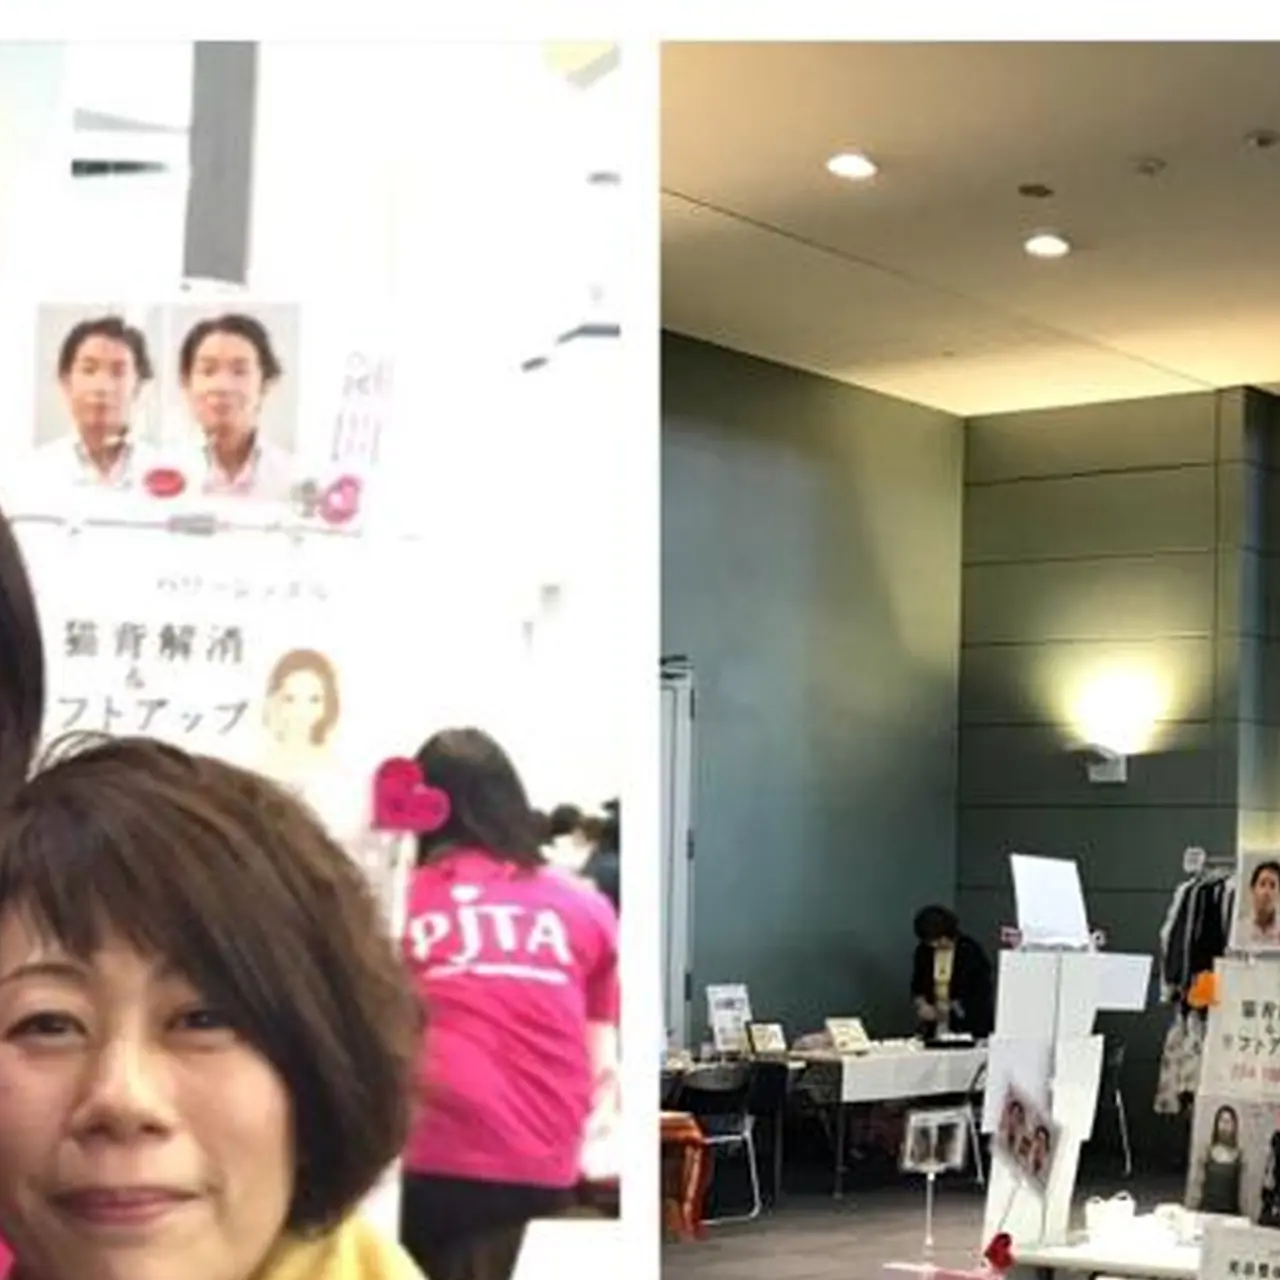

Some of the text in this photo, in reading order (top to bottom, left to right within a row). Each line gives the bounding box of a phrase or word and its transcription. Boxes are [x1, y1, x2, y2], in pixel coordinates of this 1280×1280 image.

[55, 694, 250, 735] フトアップ
